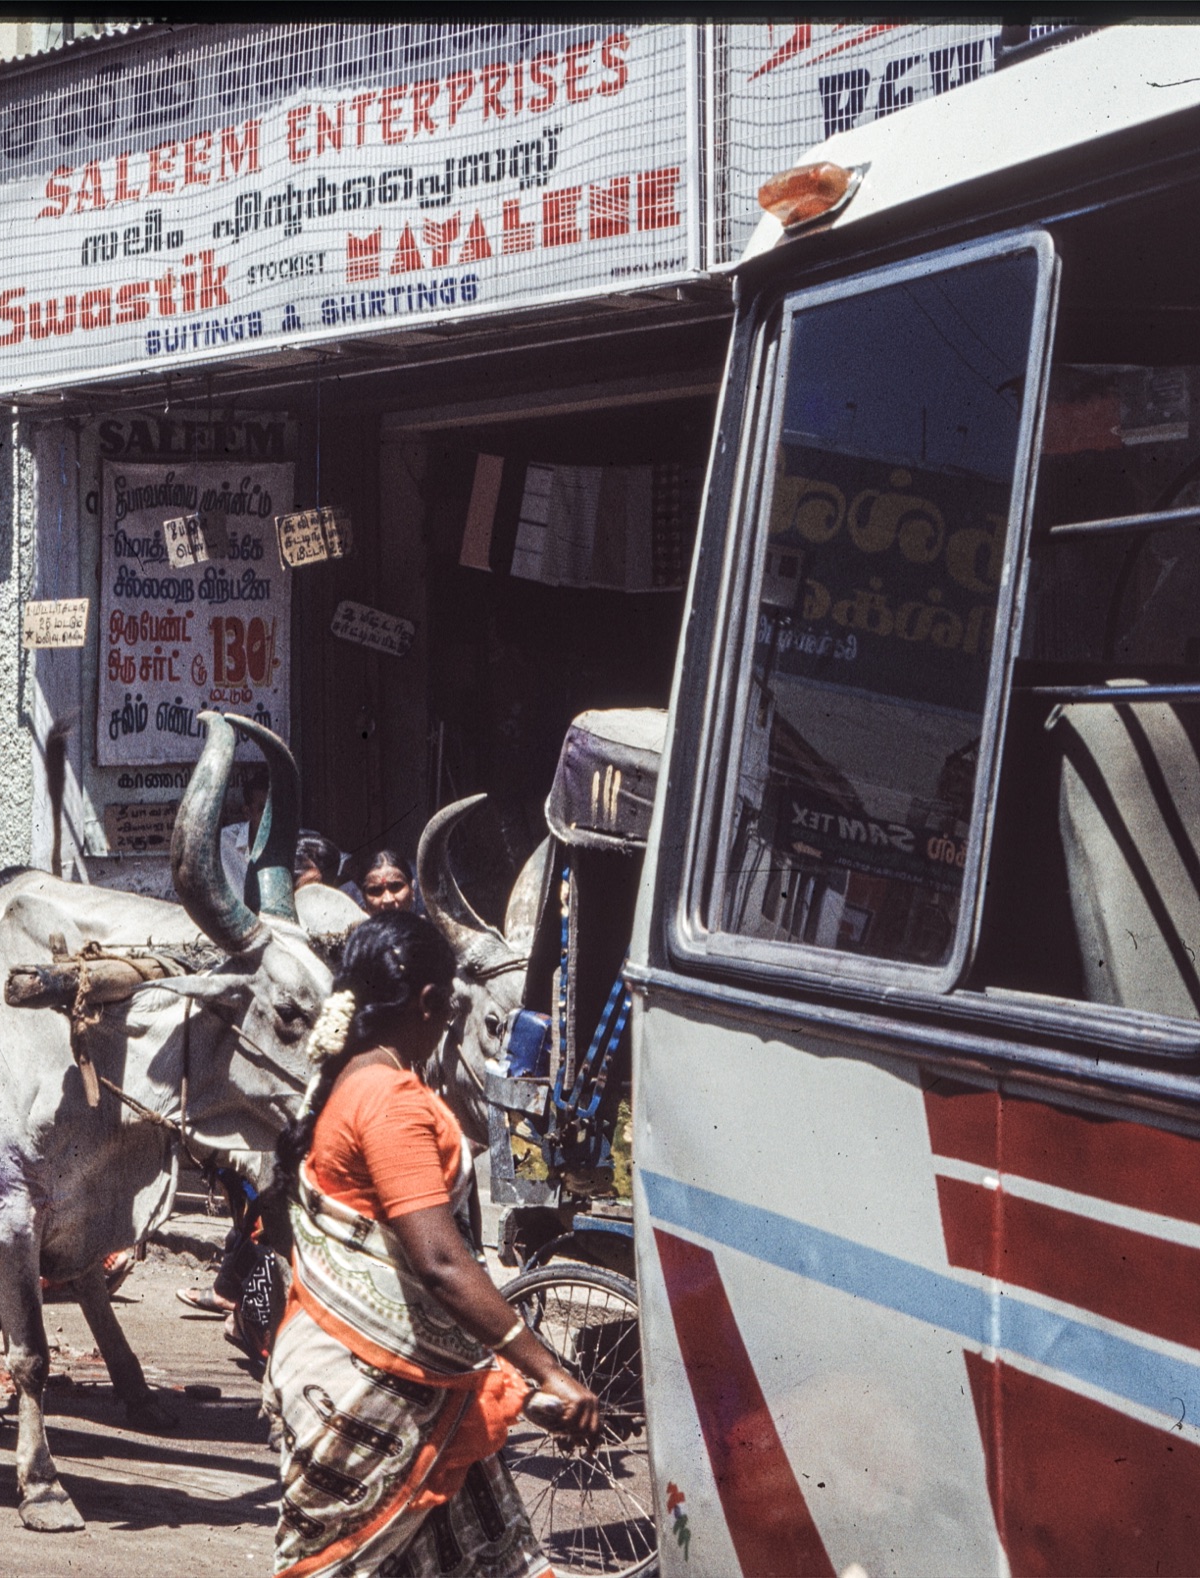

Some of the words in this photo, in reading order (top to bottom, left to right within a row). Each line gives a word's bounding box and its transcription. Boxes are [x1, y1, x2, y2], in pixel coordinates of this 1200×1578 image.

[36, 119, 262, 222] SALEEM
[286, 33, 630, 164] ENTERPRISES
[247, 253, 326, 284] STOCKIST
[345, 167, 680, 283] MAYALENE
[147, 311, 262, 355] SUITINGS
[282, 303, 305, 332] &
[321, 273, 479, 327] SHIRTINGS
[100, 420, 286, 455] SALEEM
[108, 648, 136, 684] ஒரு
